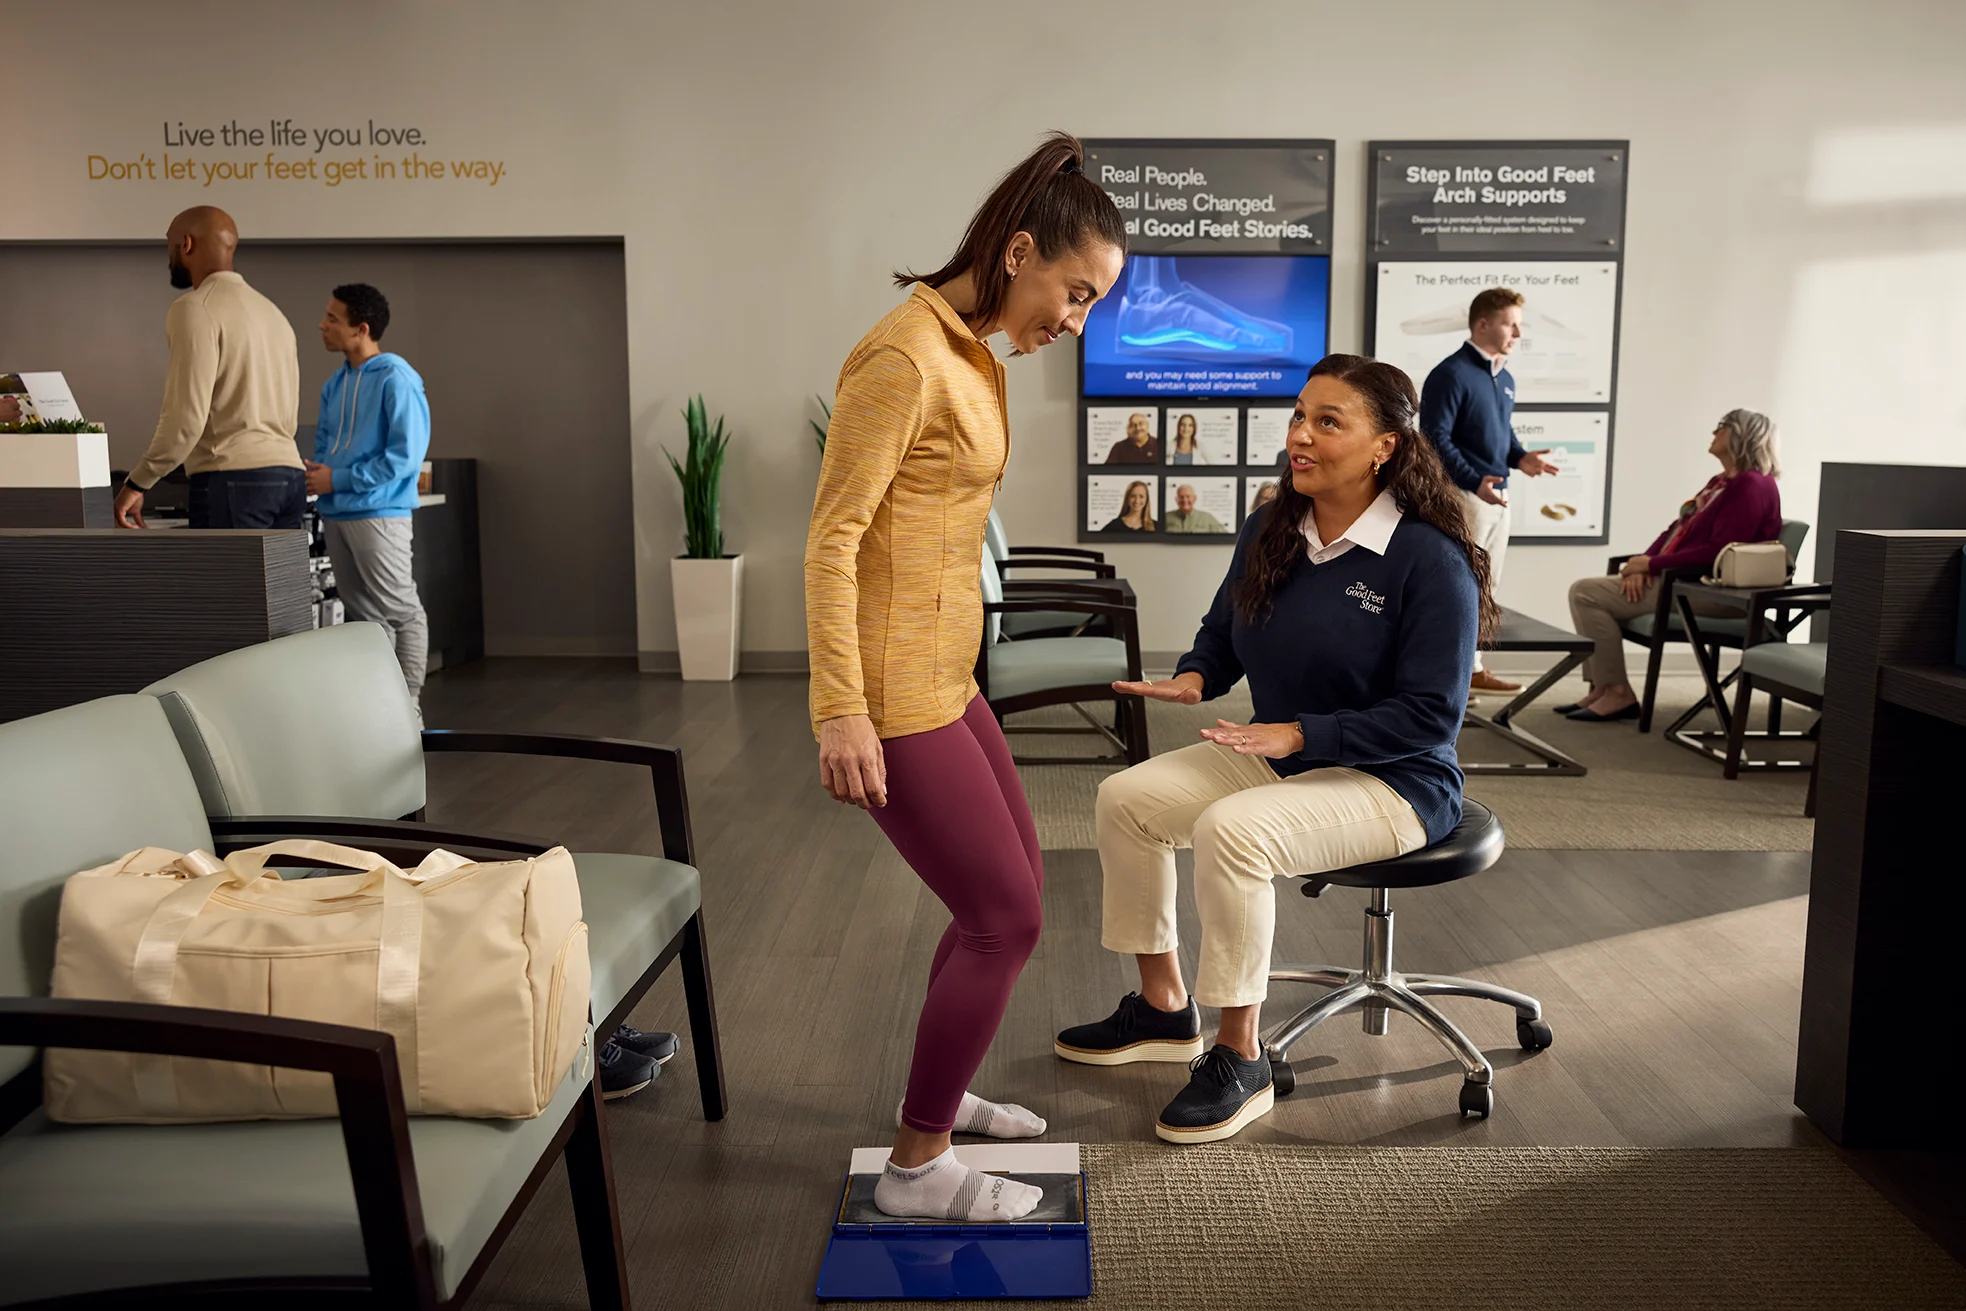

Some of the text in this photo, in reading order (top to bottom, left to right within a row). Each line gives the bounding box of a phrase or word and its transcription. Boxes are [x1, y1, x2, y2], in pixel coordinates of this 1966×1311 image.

[164, 119, 426, 154] Live the life you love.
[88, 152, 507, 187] Don't let your feet get in the way.
[1101, 165, 1208, 190] Real People.
[1406, 166, 1596, 186] Step Into Good Feet
[1144, 191, 1188, 212] Lives
[1193, 193, 1276, 217] Changed.
[1432, 186, 1567, 207] Arch Supports
[1125, 217, 1313, 239] al Good Feet Stories.
[1415, 274, 1580, 286] The Perfect Fit For Your Feet
[1125, 370, 1282, 382] and you may need some support to
[1147, 381, 1186, 390] maintain
[1187, 381, 1212, 391] good
[1514, 424, 1544, 435] stem
[1345, 585, 1386, 605] Good Feet
[1355, 581, 1367, 591] The
[1359, 599, 1385, 615] Store
